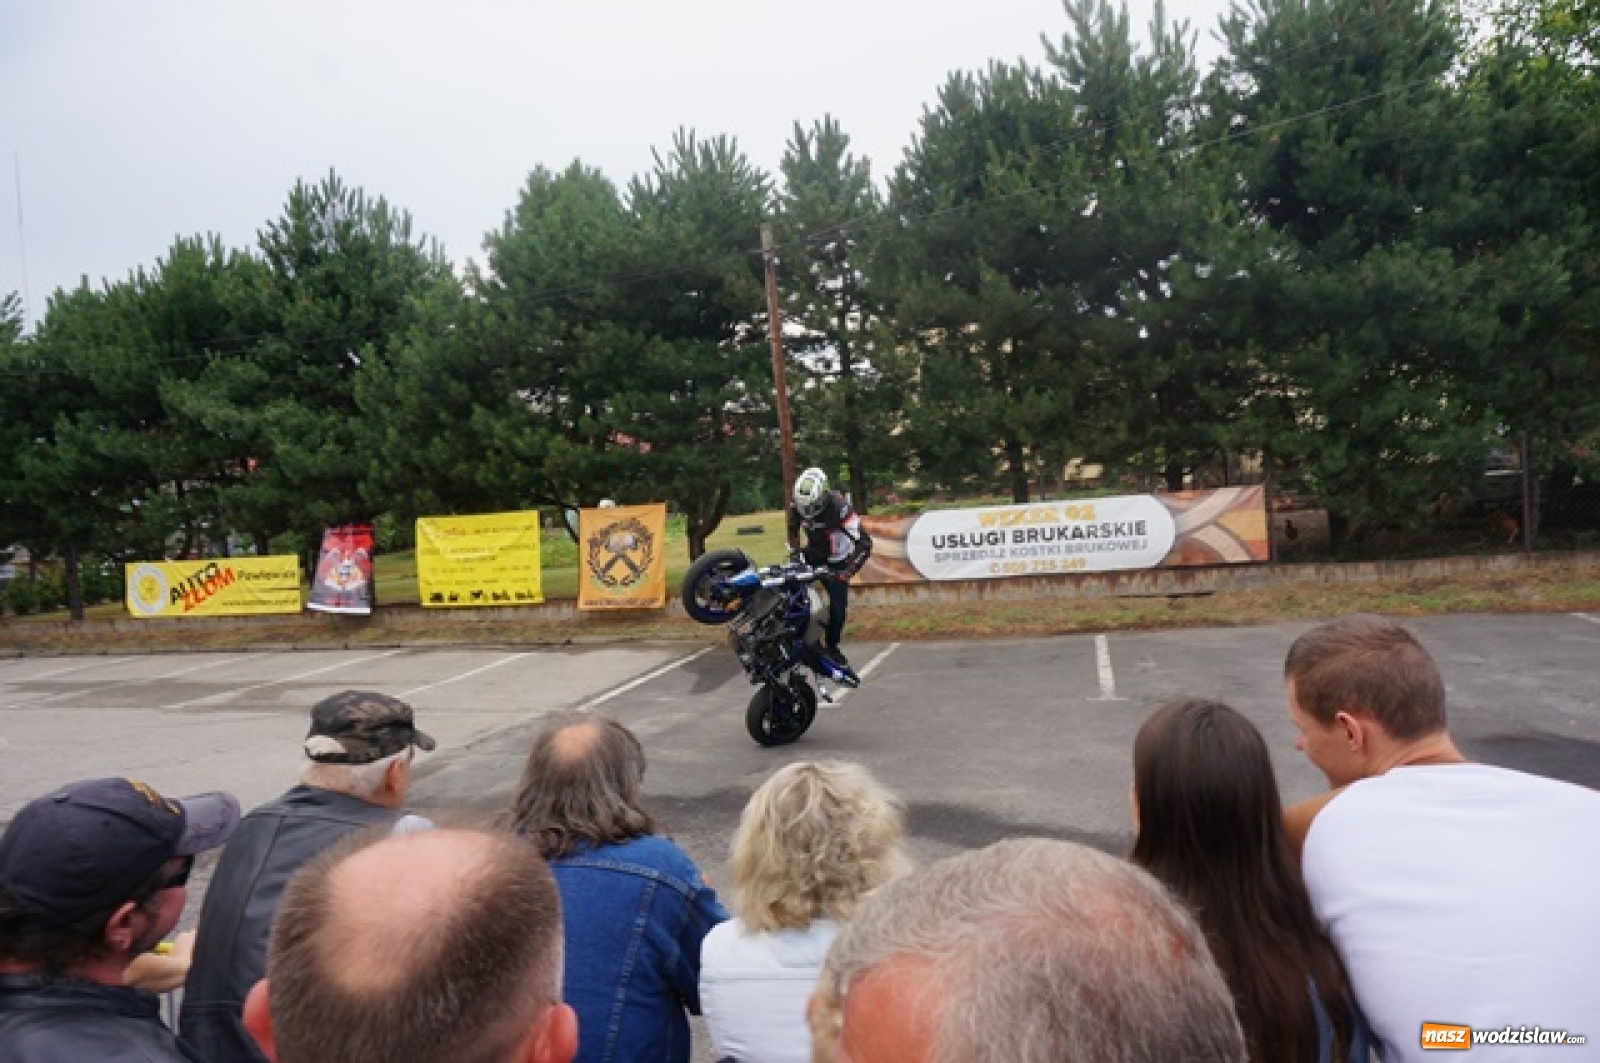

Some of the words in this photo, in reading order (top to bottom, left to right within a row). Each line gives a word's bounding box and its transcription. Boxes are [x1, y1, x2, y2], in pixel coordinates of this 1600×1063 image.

[931, 530, 1006, 549] USŁUGI
[1012, 520, 1148, 544] BRUKARSKIE
[1065, 539, 1149, 555] BRUKOWEJ
[169, 562, 219, 605] AUTO
